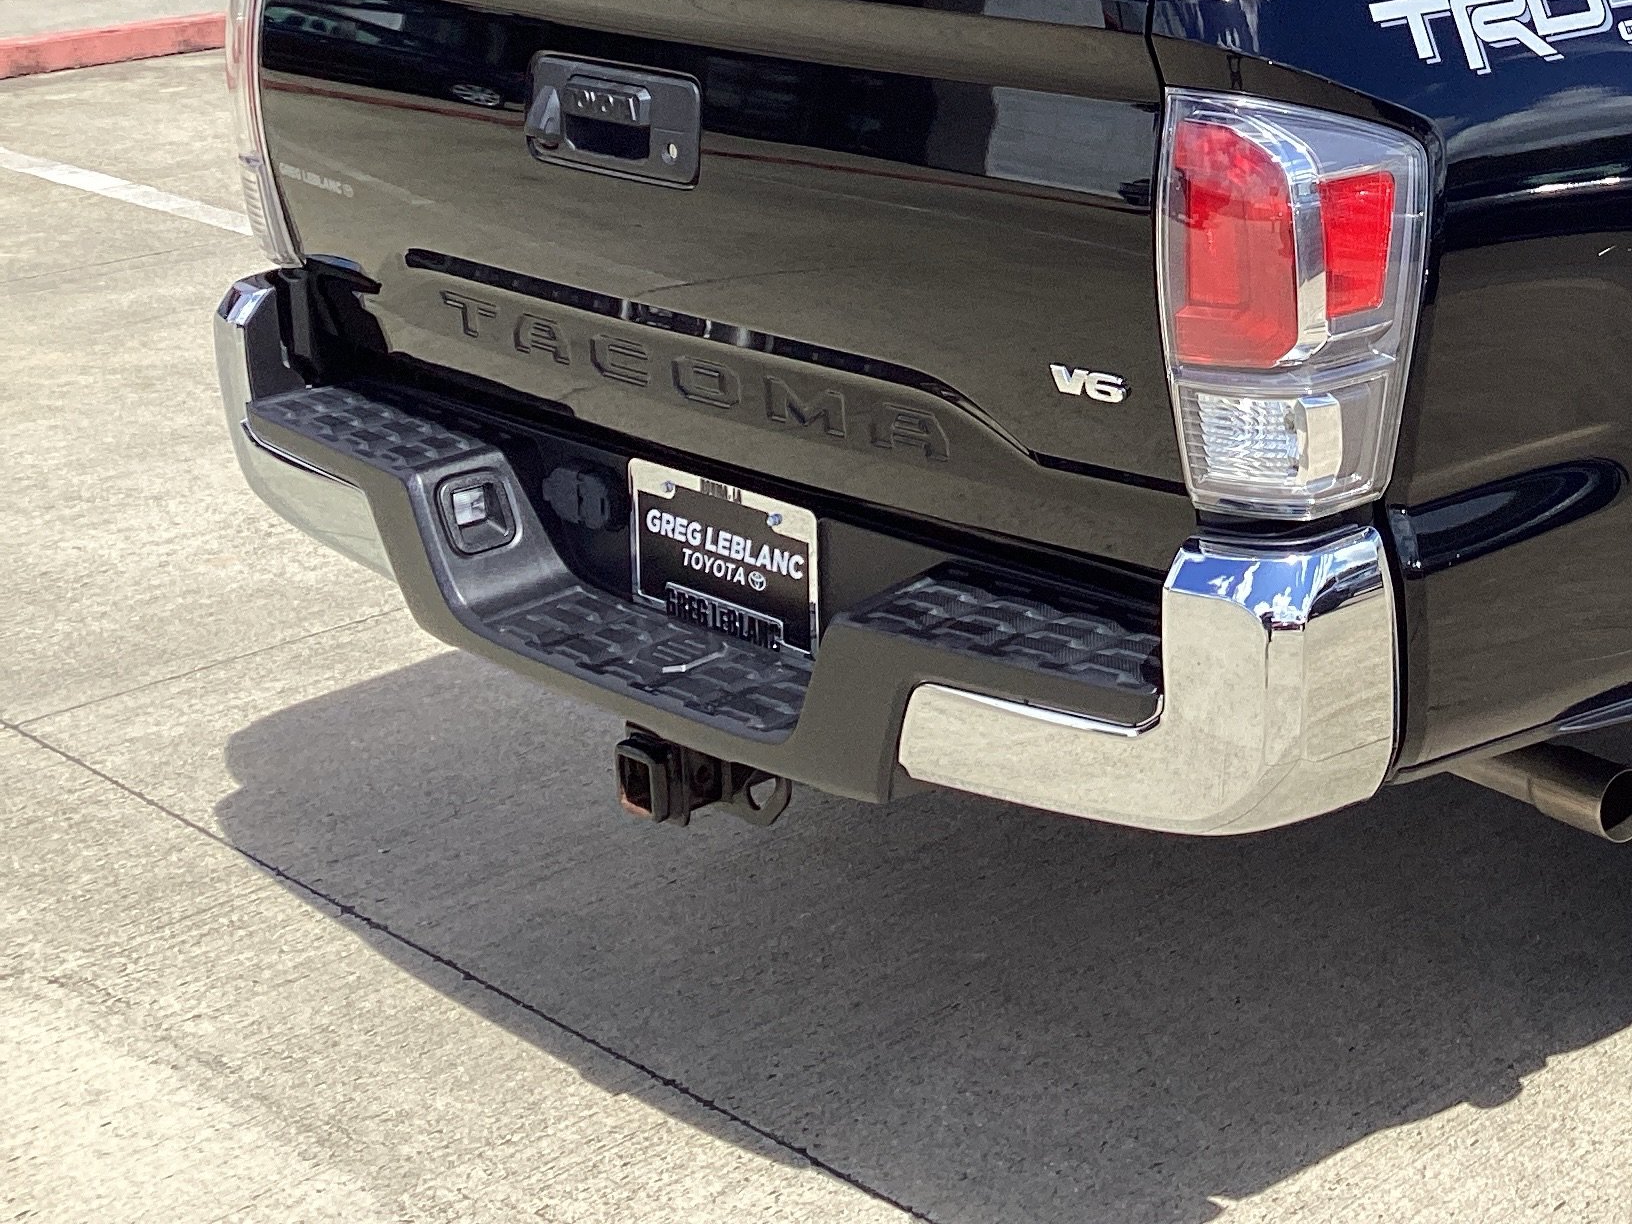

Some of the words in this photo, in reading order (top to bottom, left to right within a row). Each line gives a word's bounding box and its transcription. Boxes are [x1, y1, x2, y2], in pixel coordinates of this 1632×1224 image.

[439, 289, 951, 462] TACOMA
[1049, 362, 1131, 404] V6
[646, 509, 702, 546] GREG
[705, 526, 804, 579] LEBLANC
[682, 548, 745, 585] TOYOTA
